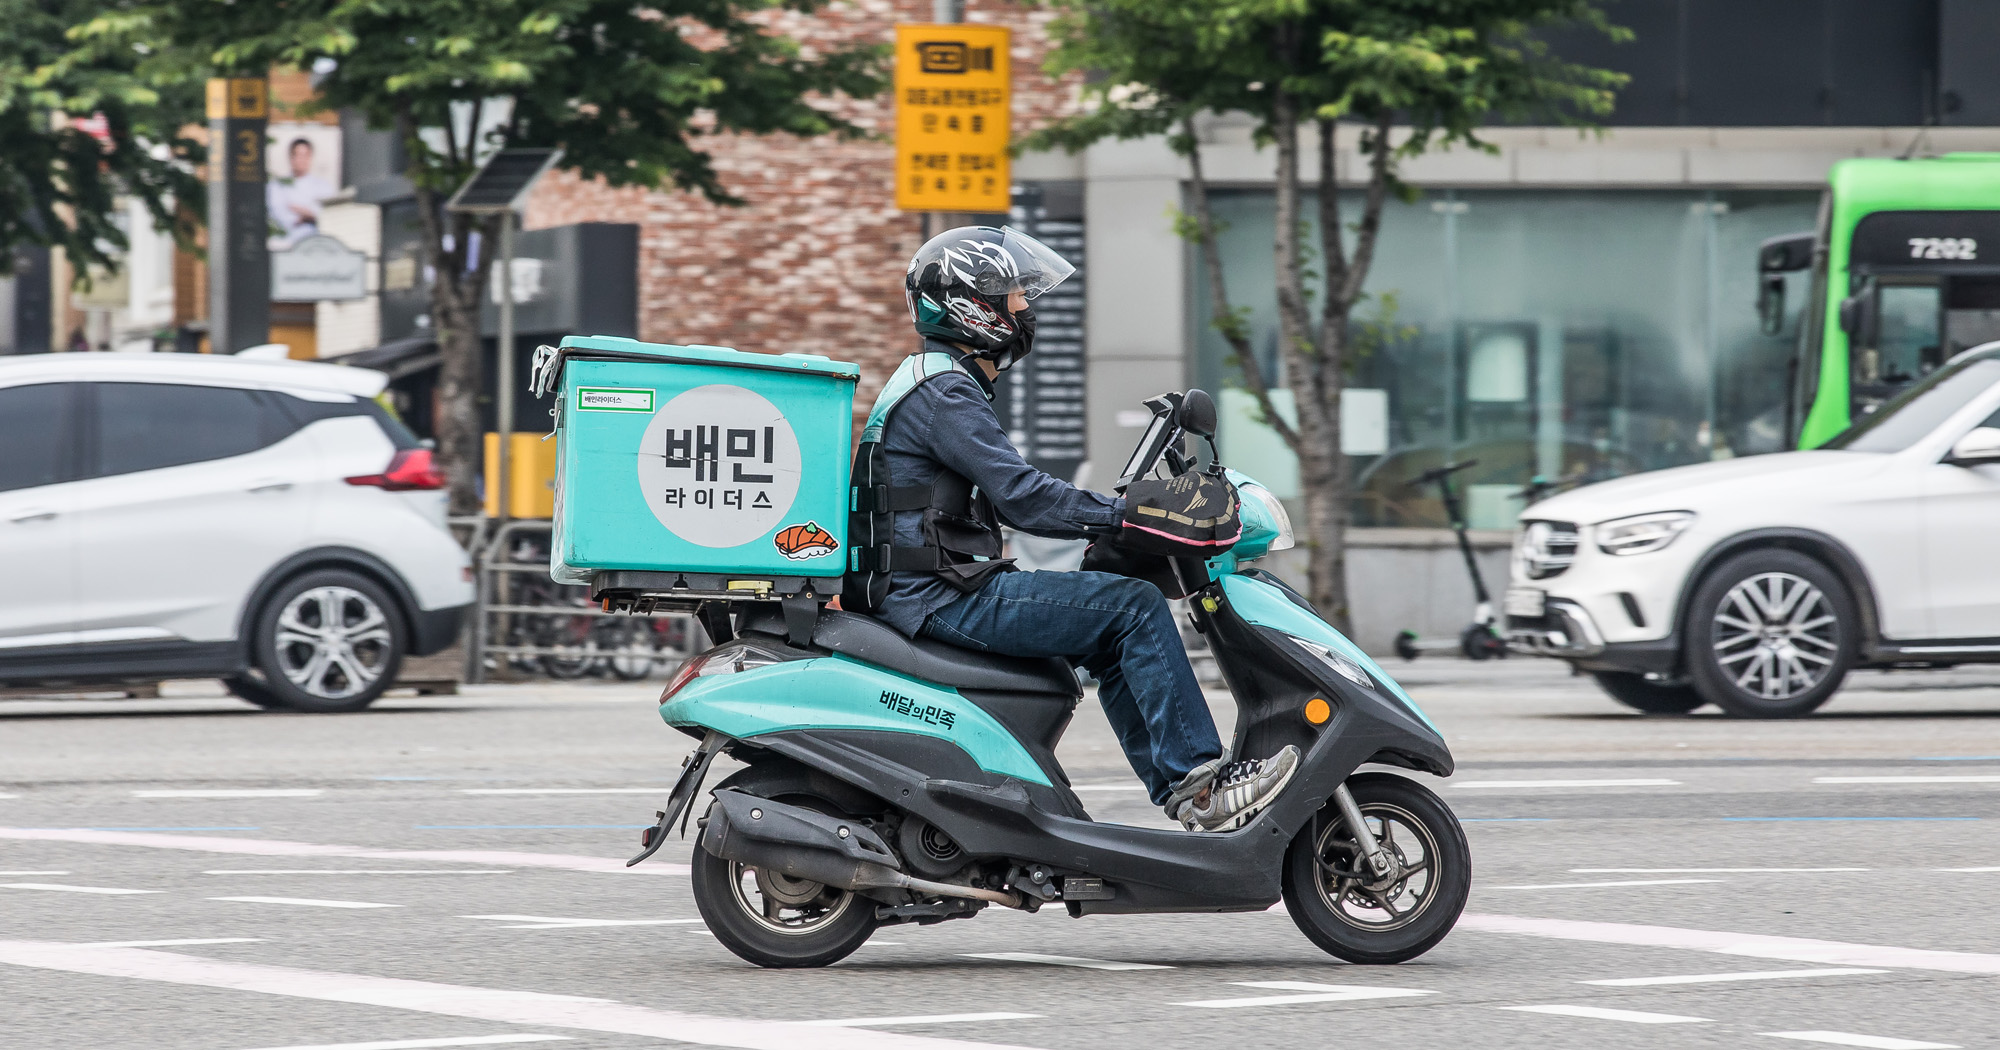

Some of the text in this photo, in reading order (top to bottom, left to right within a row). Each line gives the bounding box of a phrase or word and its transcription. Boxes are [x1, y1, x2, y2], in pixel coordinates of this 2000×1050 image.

[1907, 237, 1978, 260] 7202
[584, 396, 622, 404] 배민라이더스
[665, 424, 774, 483] 배민
[665, 487, 773, 510] 라이더스
[879, 690, 956, 730] 배달의민족
